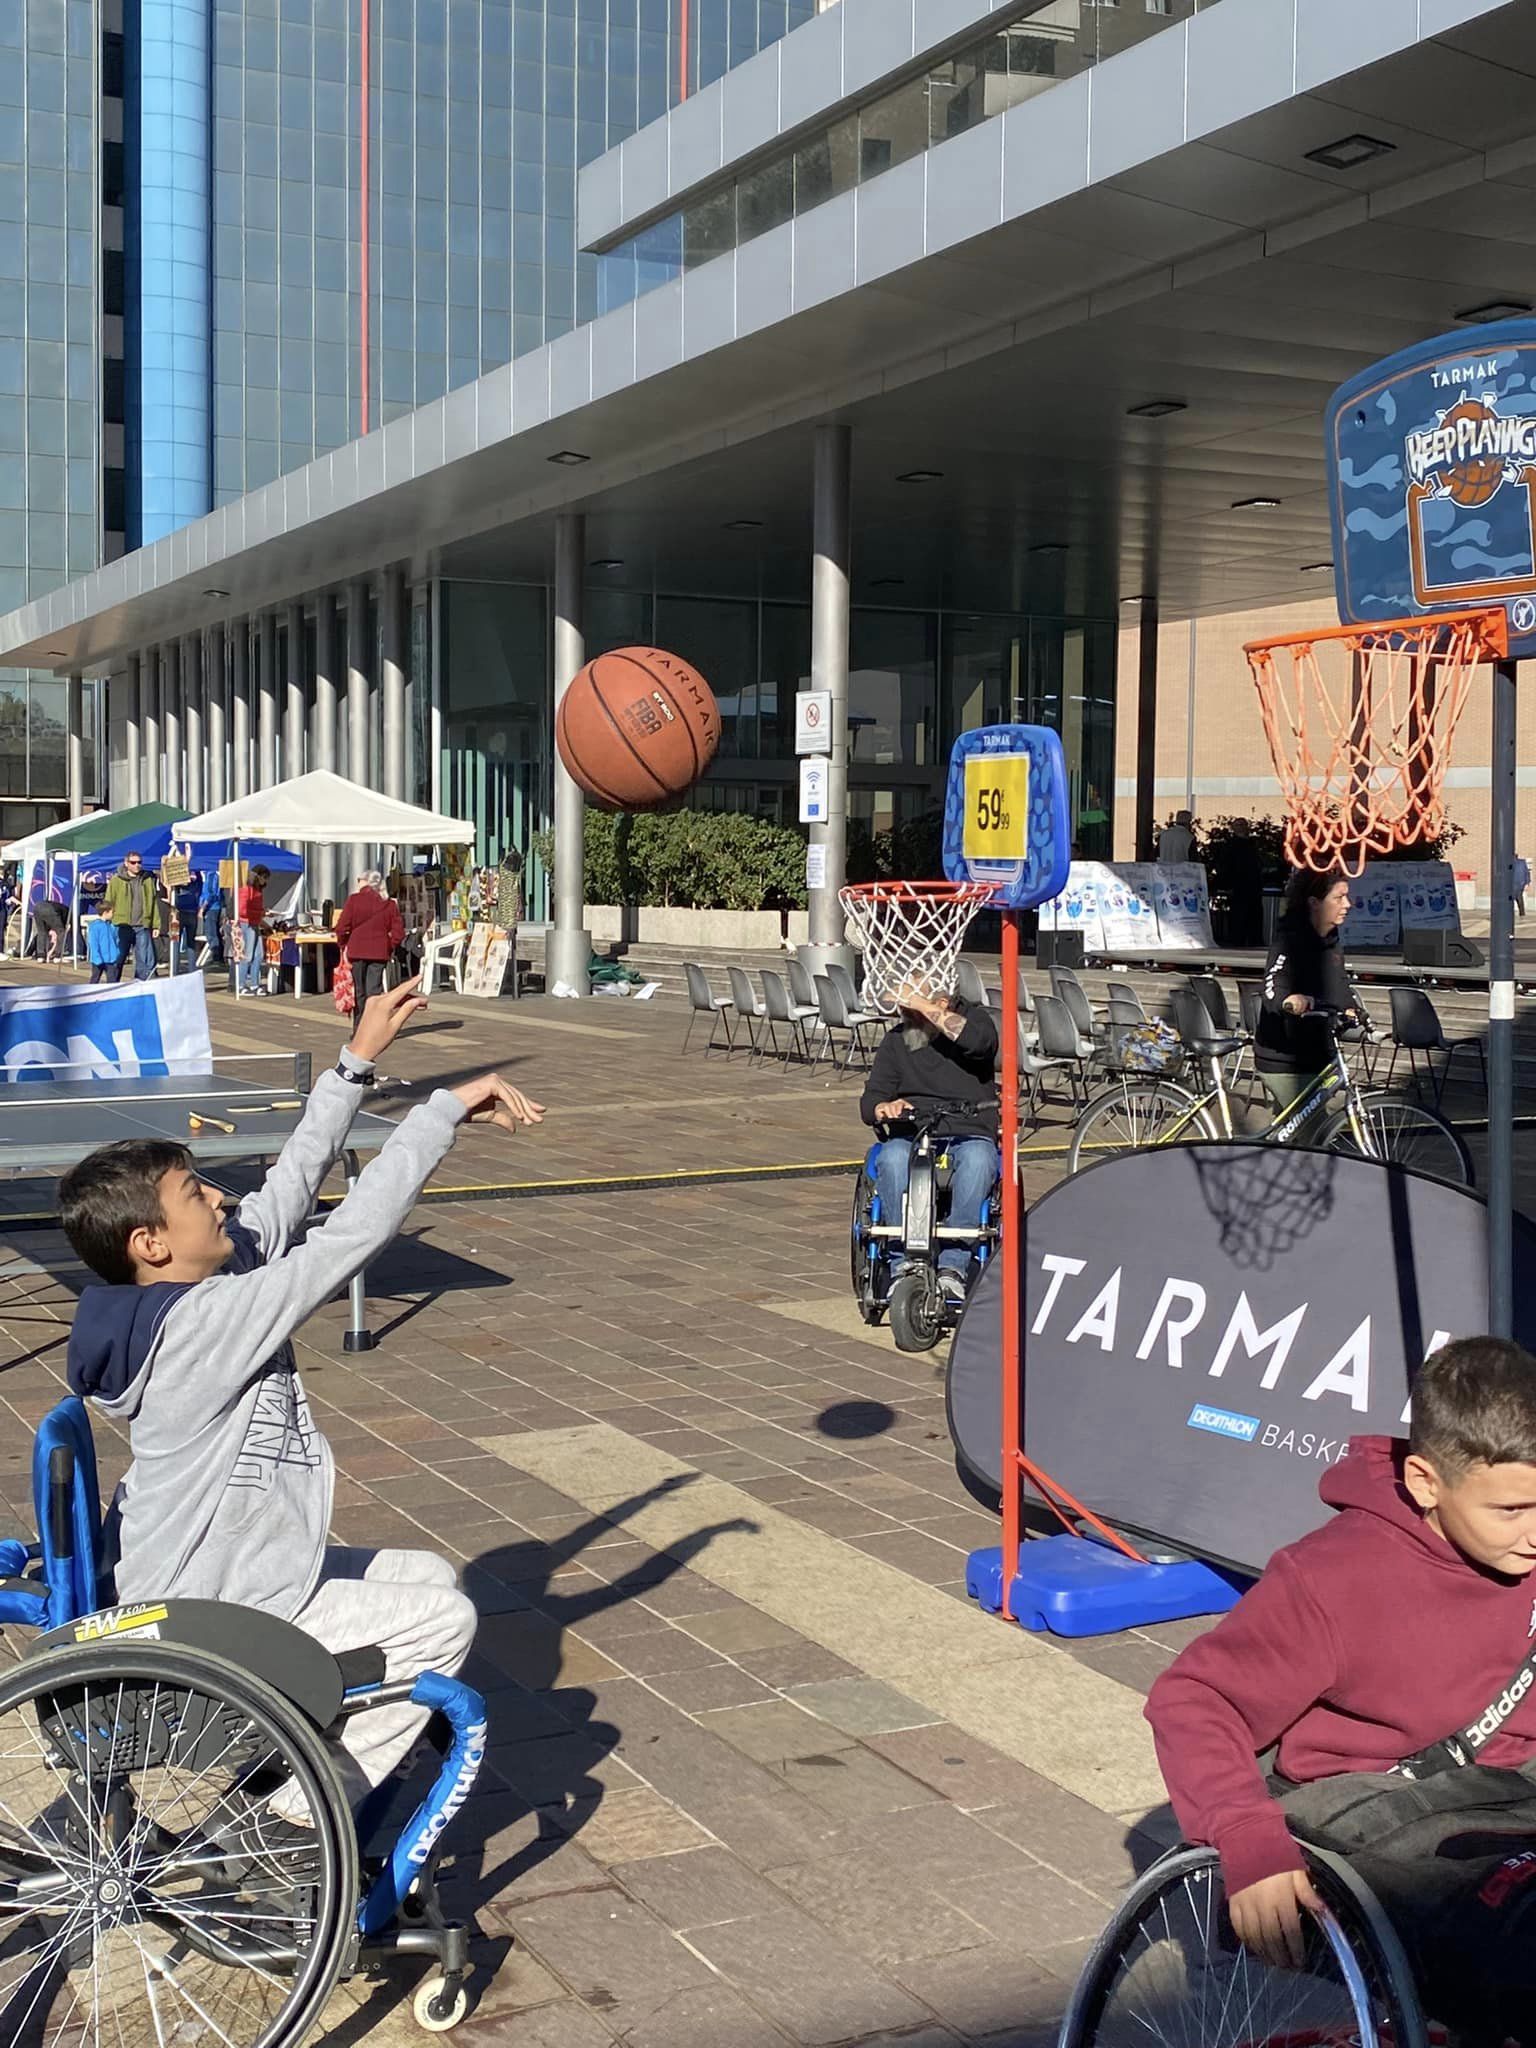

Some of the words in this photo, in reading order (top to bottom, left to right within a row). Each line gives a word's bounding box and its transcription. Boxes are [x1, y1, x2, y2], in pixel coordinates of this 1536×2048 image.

[1431, 360, 1498, 389] TARMAK
[630, 698, 662, 735] FIBA
[646, 652, 714, 746] TARMAK
[1192, 1409, 1256, 1437] DECATHLON
[407, 1721, 488, 1865] DECATHLON
